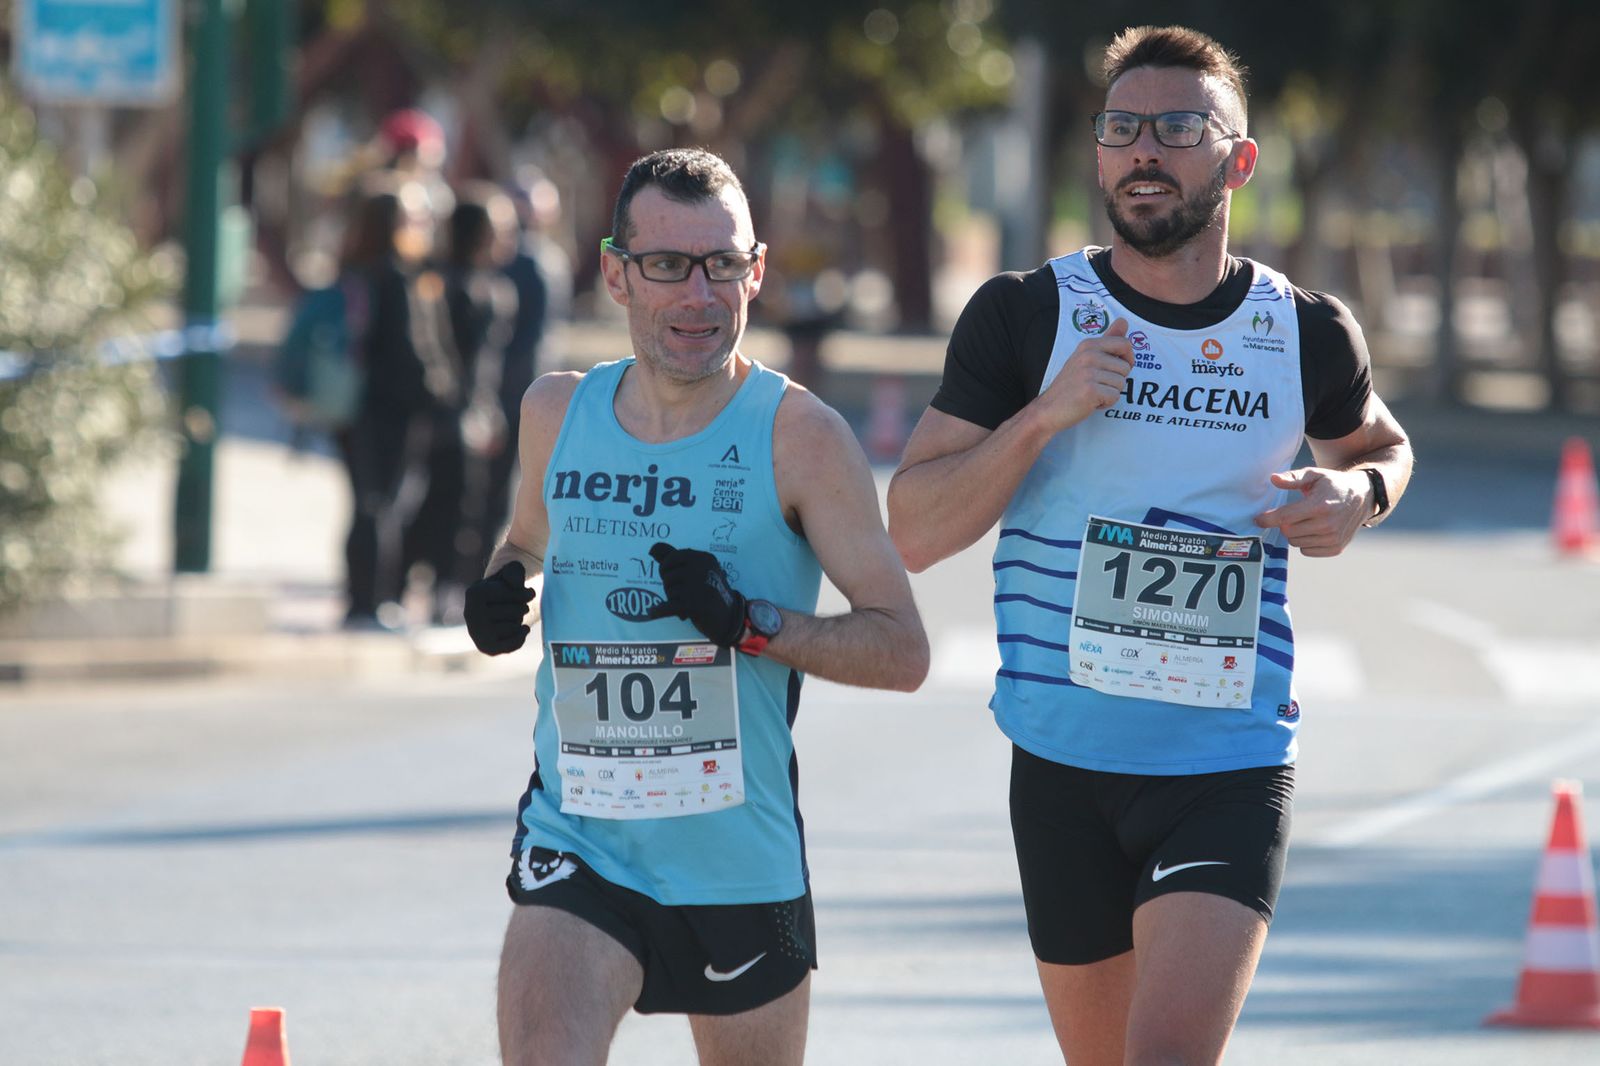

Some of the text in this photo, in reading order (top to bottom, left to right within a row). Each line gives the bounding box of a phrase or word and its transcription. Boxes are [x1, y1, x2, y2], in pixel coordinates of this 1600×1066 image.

[1242, 335, 1285, 345] Ayuntamiento
[1249, 343, 1285, 353] Maracena
[1135, 353, 1155, 361] ORT
[1191, 363, 1244, 377] mayfo
[1120, 378, 1269, 419] ARACENA
[1104, 408, 1247, 433] CLUB DE ATLETISMO
[552, 464, 696, 517] nerja
[713, 488, 744, 498] Centro
[713, 497, 742, 510] aen
[563, 516, 671, 539] ATLETISMO
[1140, 530, 1207, 545] Medio Maratón
[1139, 538, 1205, 555] Almería 2022
[590, 559, 619, 571] activa
[1104, 551, 1245, 613] 1270
[1132, 606, 1210, 627] SIMONMM
[1151, 621, 1178, 630] MAESTRA
[1179, 625, 1208, 634] TORRALVO
[595, 646, 658, 655] Medio Maratón
[1079, 642, 1103, 654] NEXA
[1120, 647, 1140, 659] CDX
[595, 655, 658, 665] Almería 2022
[586, 671, 698, 722] 104
[595, 725, 684, 738] MANOLILLO
[598, 769, 615, 780] CDX
